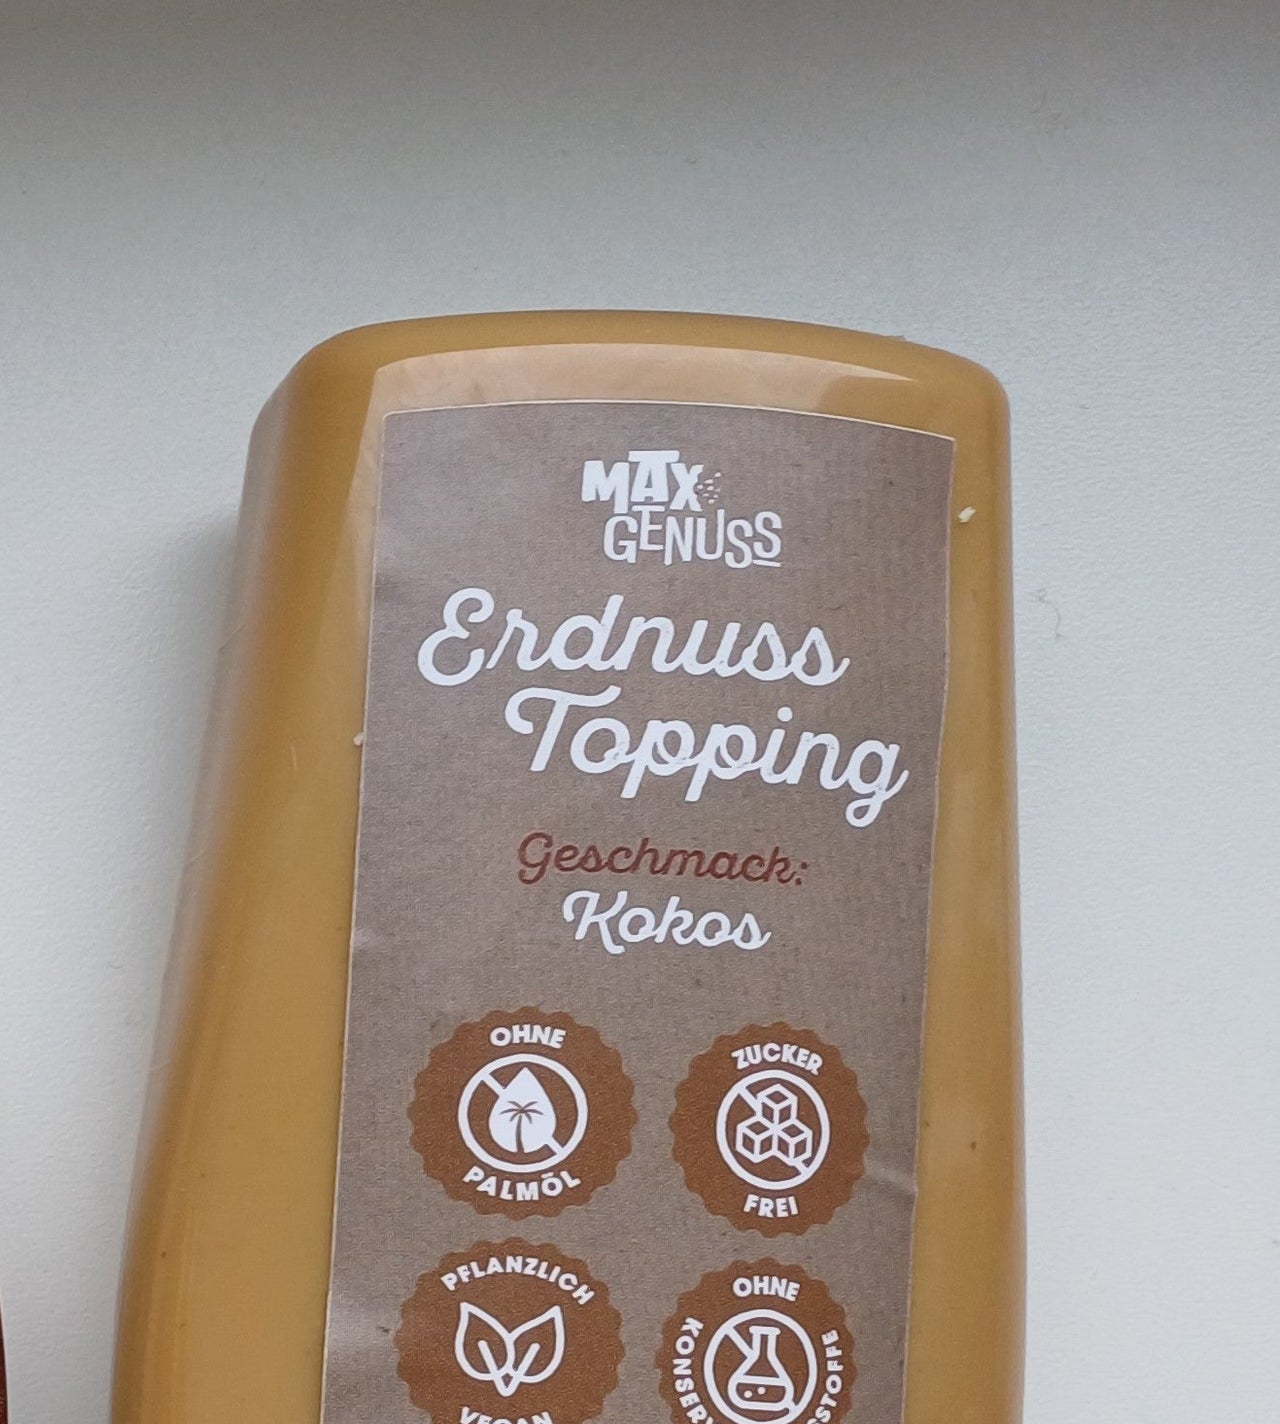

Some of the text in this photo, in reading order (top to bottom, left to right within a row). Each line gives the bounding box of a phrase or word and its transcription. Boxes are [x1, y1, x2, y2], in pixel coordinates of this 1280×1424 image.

[581, 450, 704, 513] MAX
[603, 505, 782, 568] GENUSS
[417, 587, 850, 685] Erdnuss
[504, 685, 909, 827] Topping
[517, 832, 808, 885] Geschmack:
[562, 890, 771, 954] Kokos
[490, 1024, 566, 1050] OHNE
[731, 1043, 823, 1075] ZUCKER
[463, 1167, 581, 1201] PALMÖL
[743, 1194, 799, 1218] FREI
[440, 1255, 595, 1305] PFLANZLICH
[732, 1276, 800, 1302] OHNE
